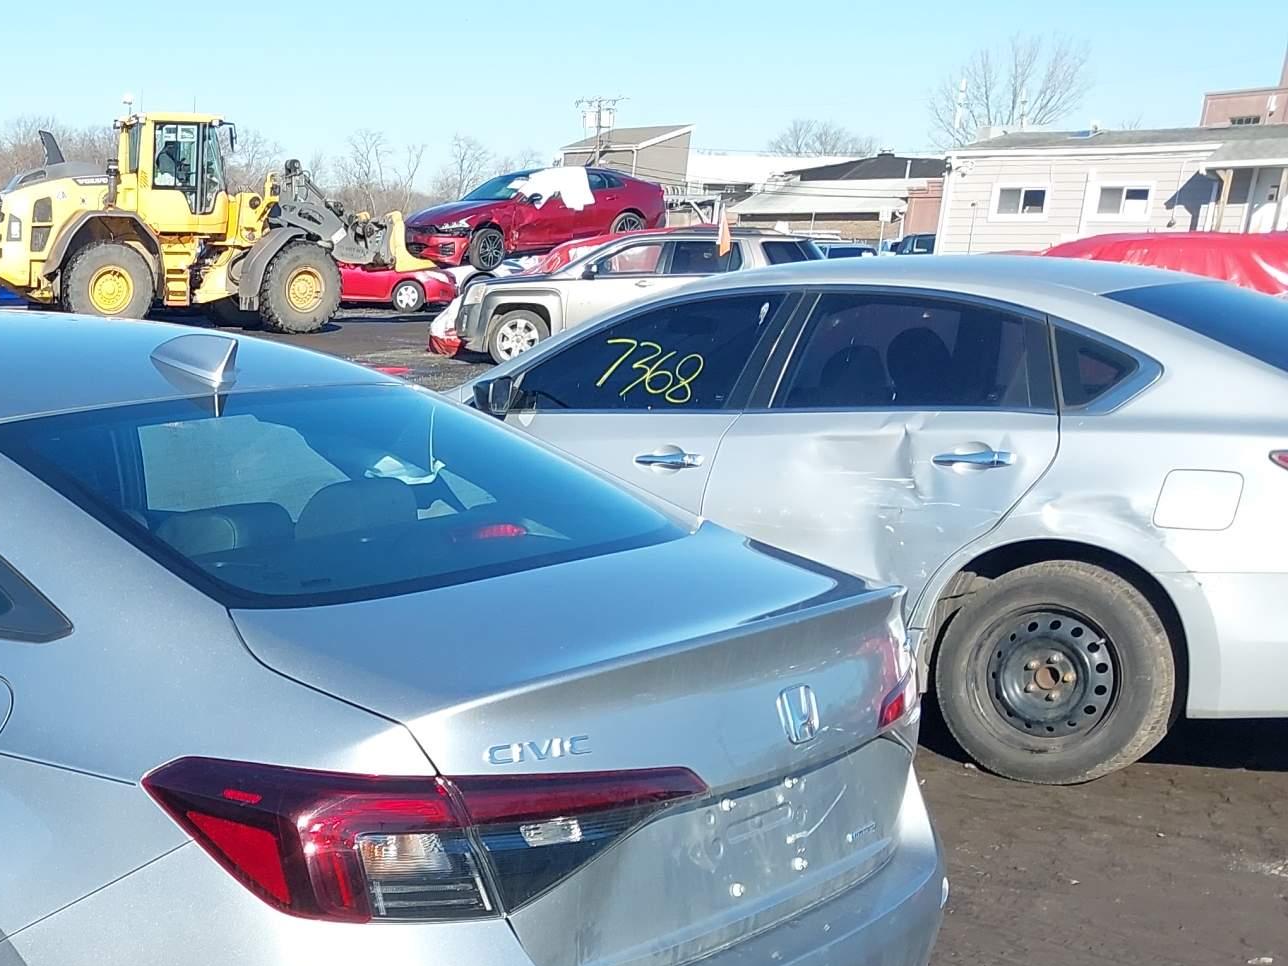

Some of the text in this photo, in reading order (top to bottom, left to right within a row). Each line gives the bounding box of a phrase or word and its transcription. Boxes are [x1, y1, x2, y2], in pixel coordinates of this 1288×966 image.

[76, 177, 109, 185] VOLVO
[595, 338, 704, 404] 7368
[482, 734, 593, 765] CIVIC
